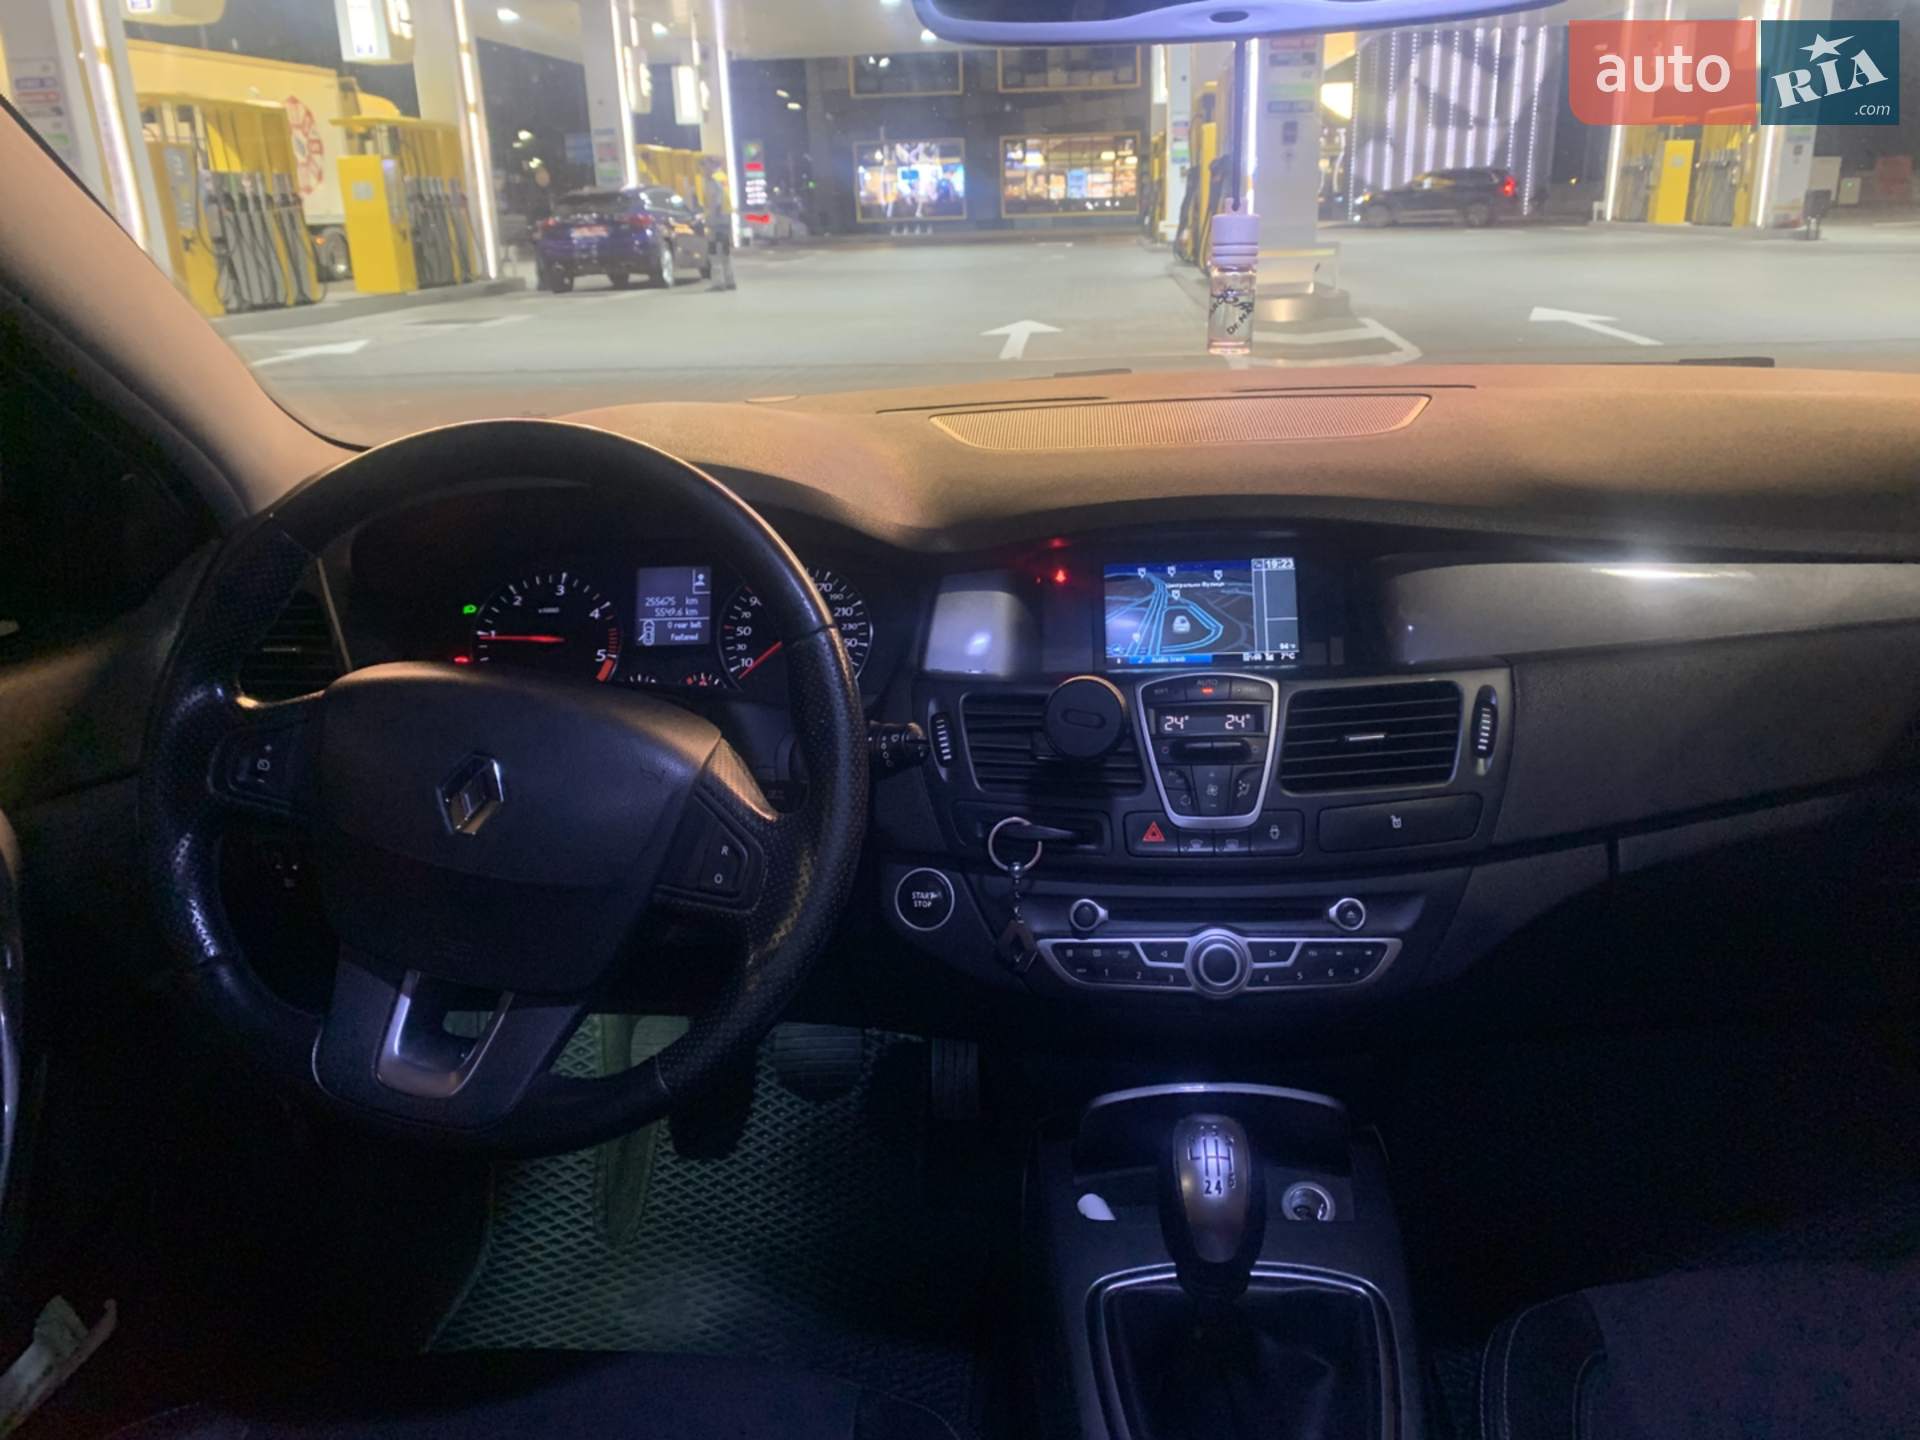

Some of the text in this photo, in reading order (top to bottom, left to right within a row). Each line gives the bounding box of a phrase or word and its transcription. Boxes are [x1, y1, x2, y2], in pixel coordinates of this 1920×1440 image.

[1265, 560, 1294, 569] 19:23
[556, 585, 566, 596] 3
[817, 583, 833, 592] 70
[513, 596, 523, 606] 2
[685, 596, 699, 605] km
[589, 608, 601, 619] 4
[685, 607, 699, 616] km
[741, 611, 751, 619] 70
[834, 607, 854, 617] 210
[736, 626, 752, 636] 50
[841, 623, 858, 631] 230
[736, 643, 747, 651] 30
[596, 649, 607, 662] 5
[740, 658, 753, 668] 10
[1164, 715, 1190, 731] 24°
[1225, 714, 1251, 730] 24°
[912, 891, 935, 900] START
[913, 900, 932, 908] STOP
[1204, 1180, 1223, 1196] 2 4
